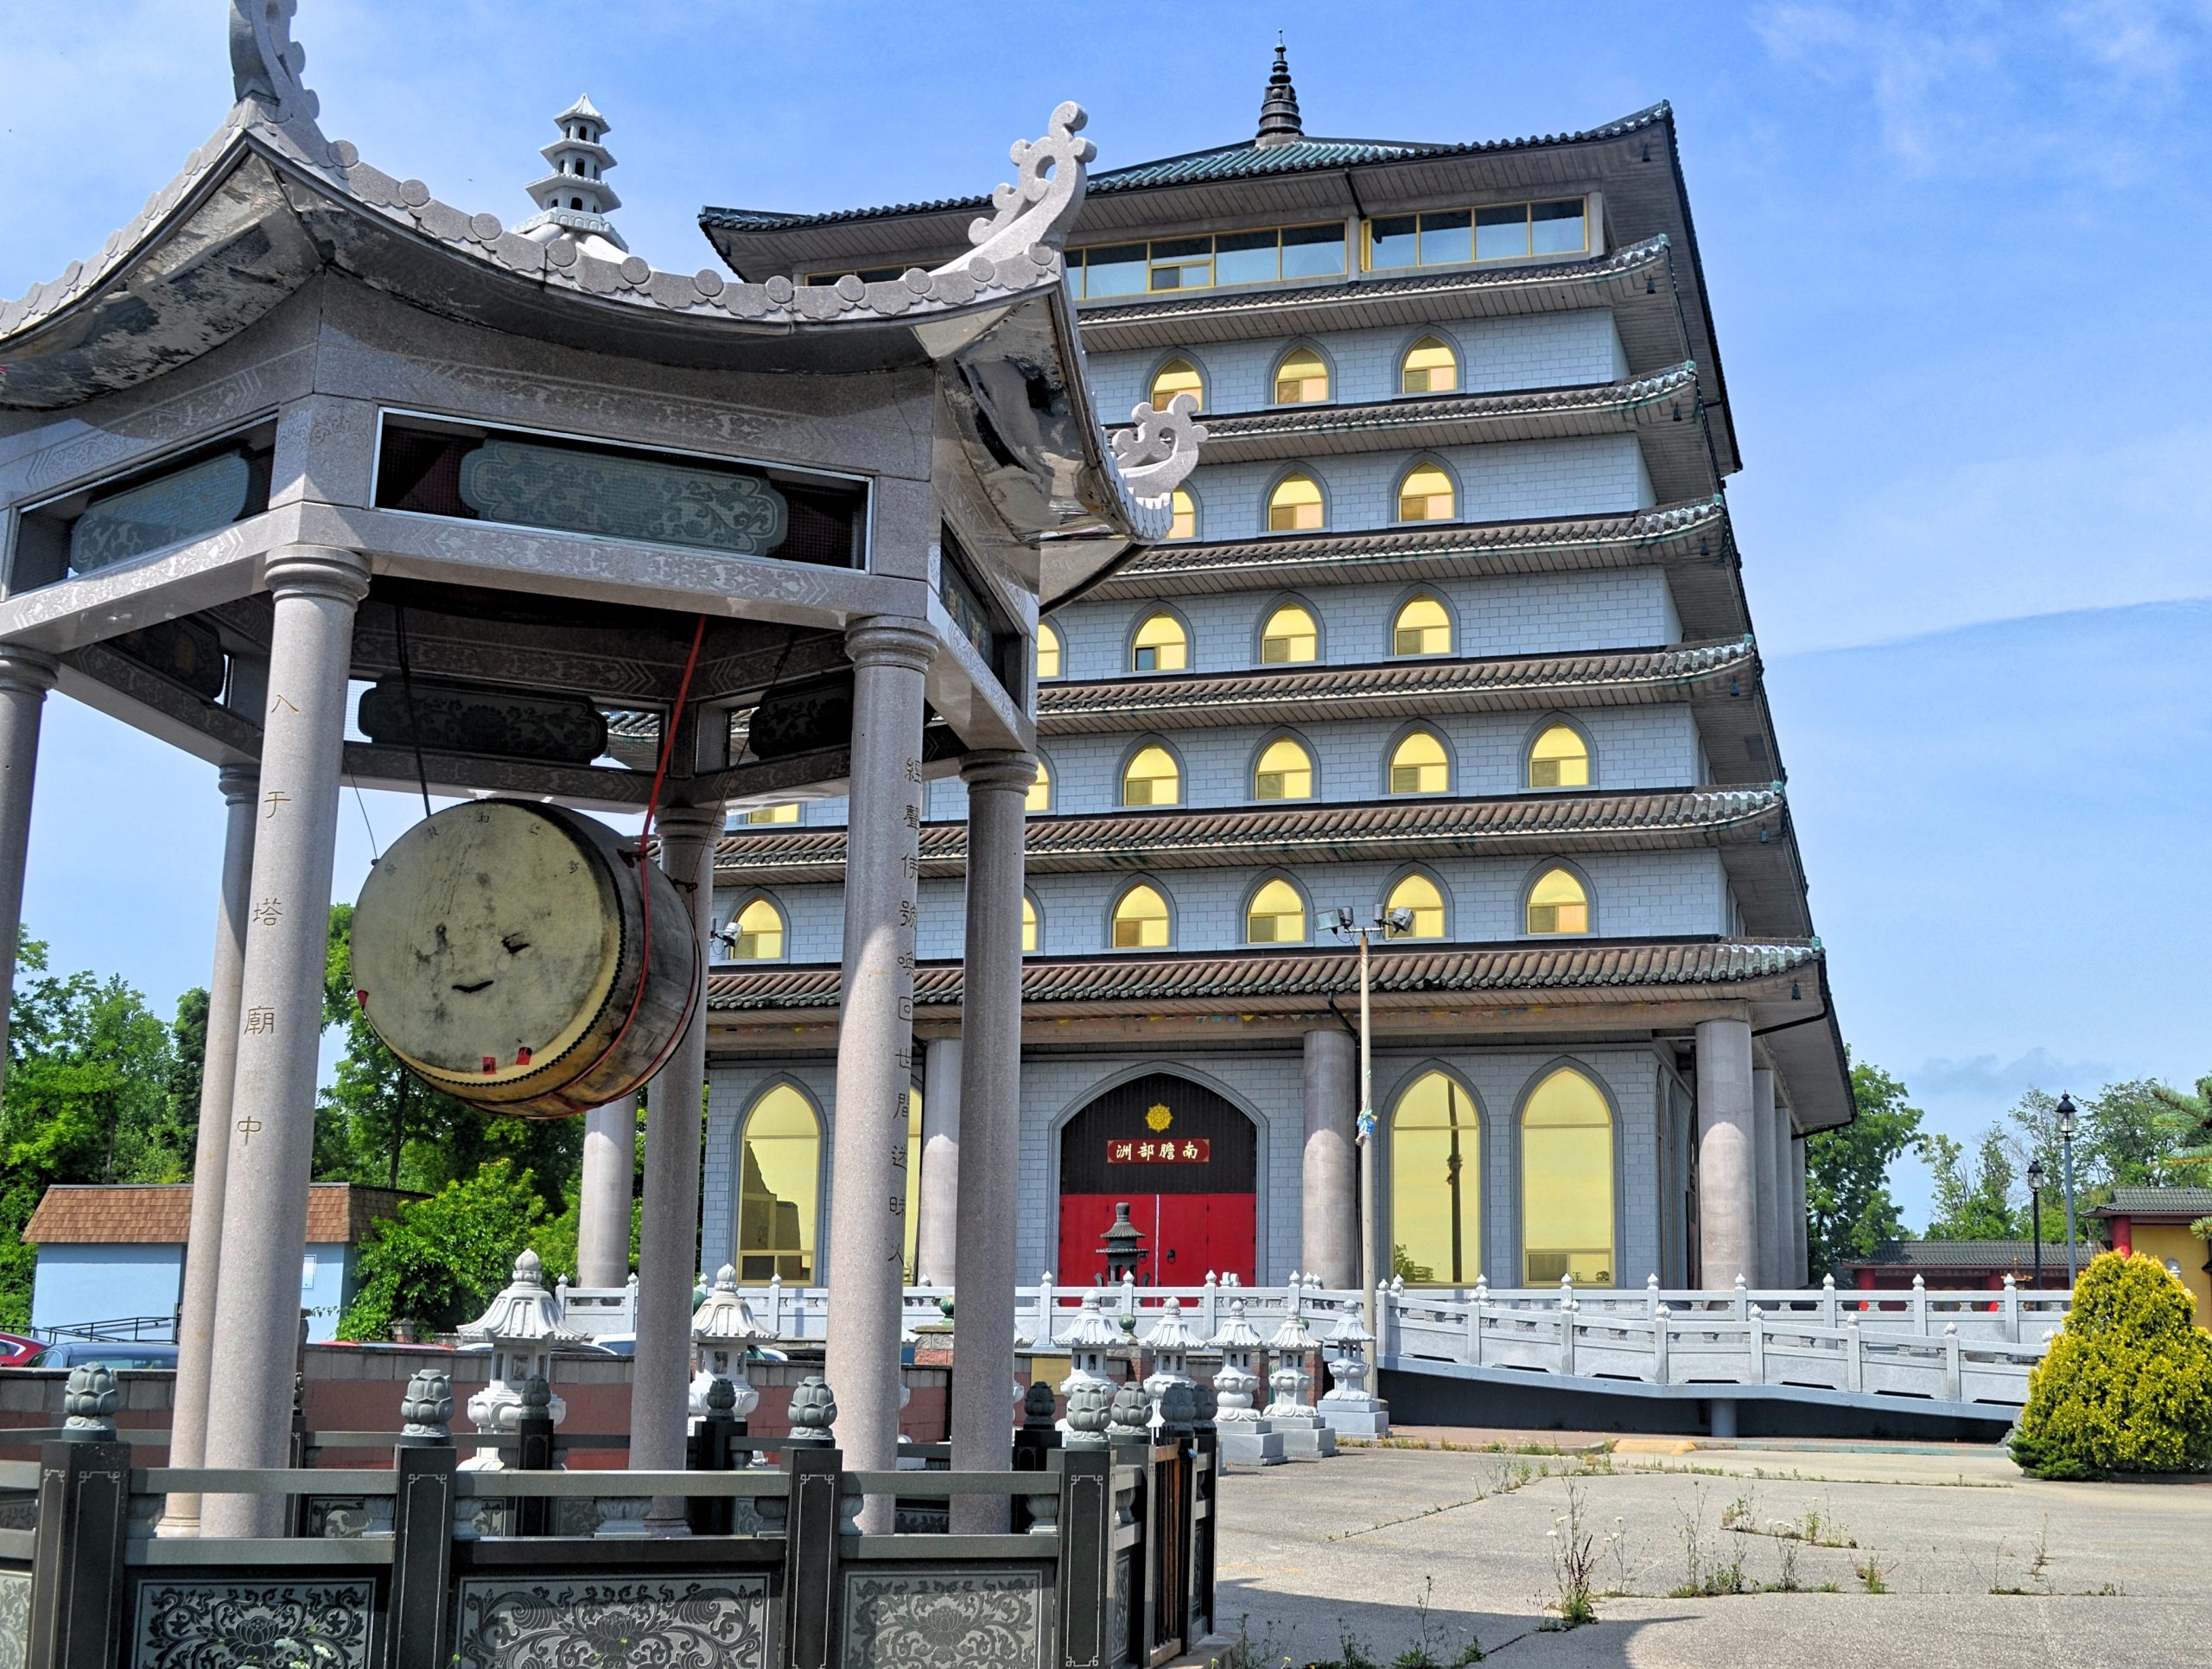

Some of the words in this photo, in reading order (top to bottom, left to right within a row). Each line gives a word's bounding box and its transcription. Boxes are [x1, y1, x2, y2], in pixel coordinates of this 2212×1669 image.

[237, 694, 300, 1146] 入于塔廟中
